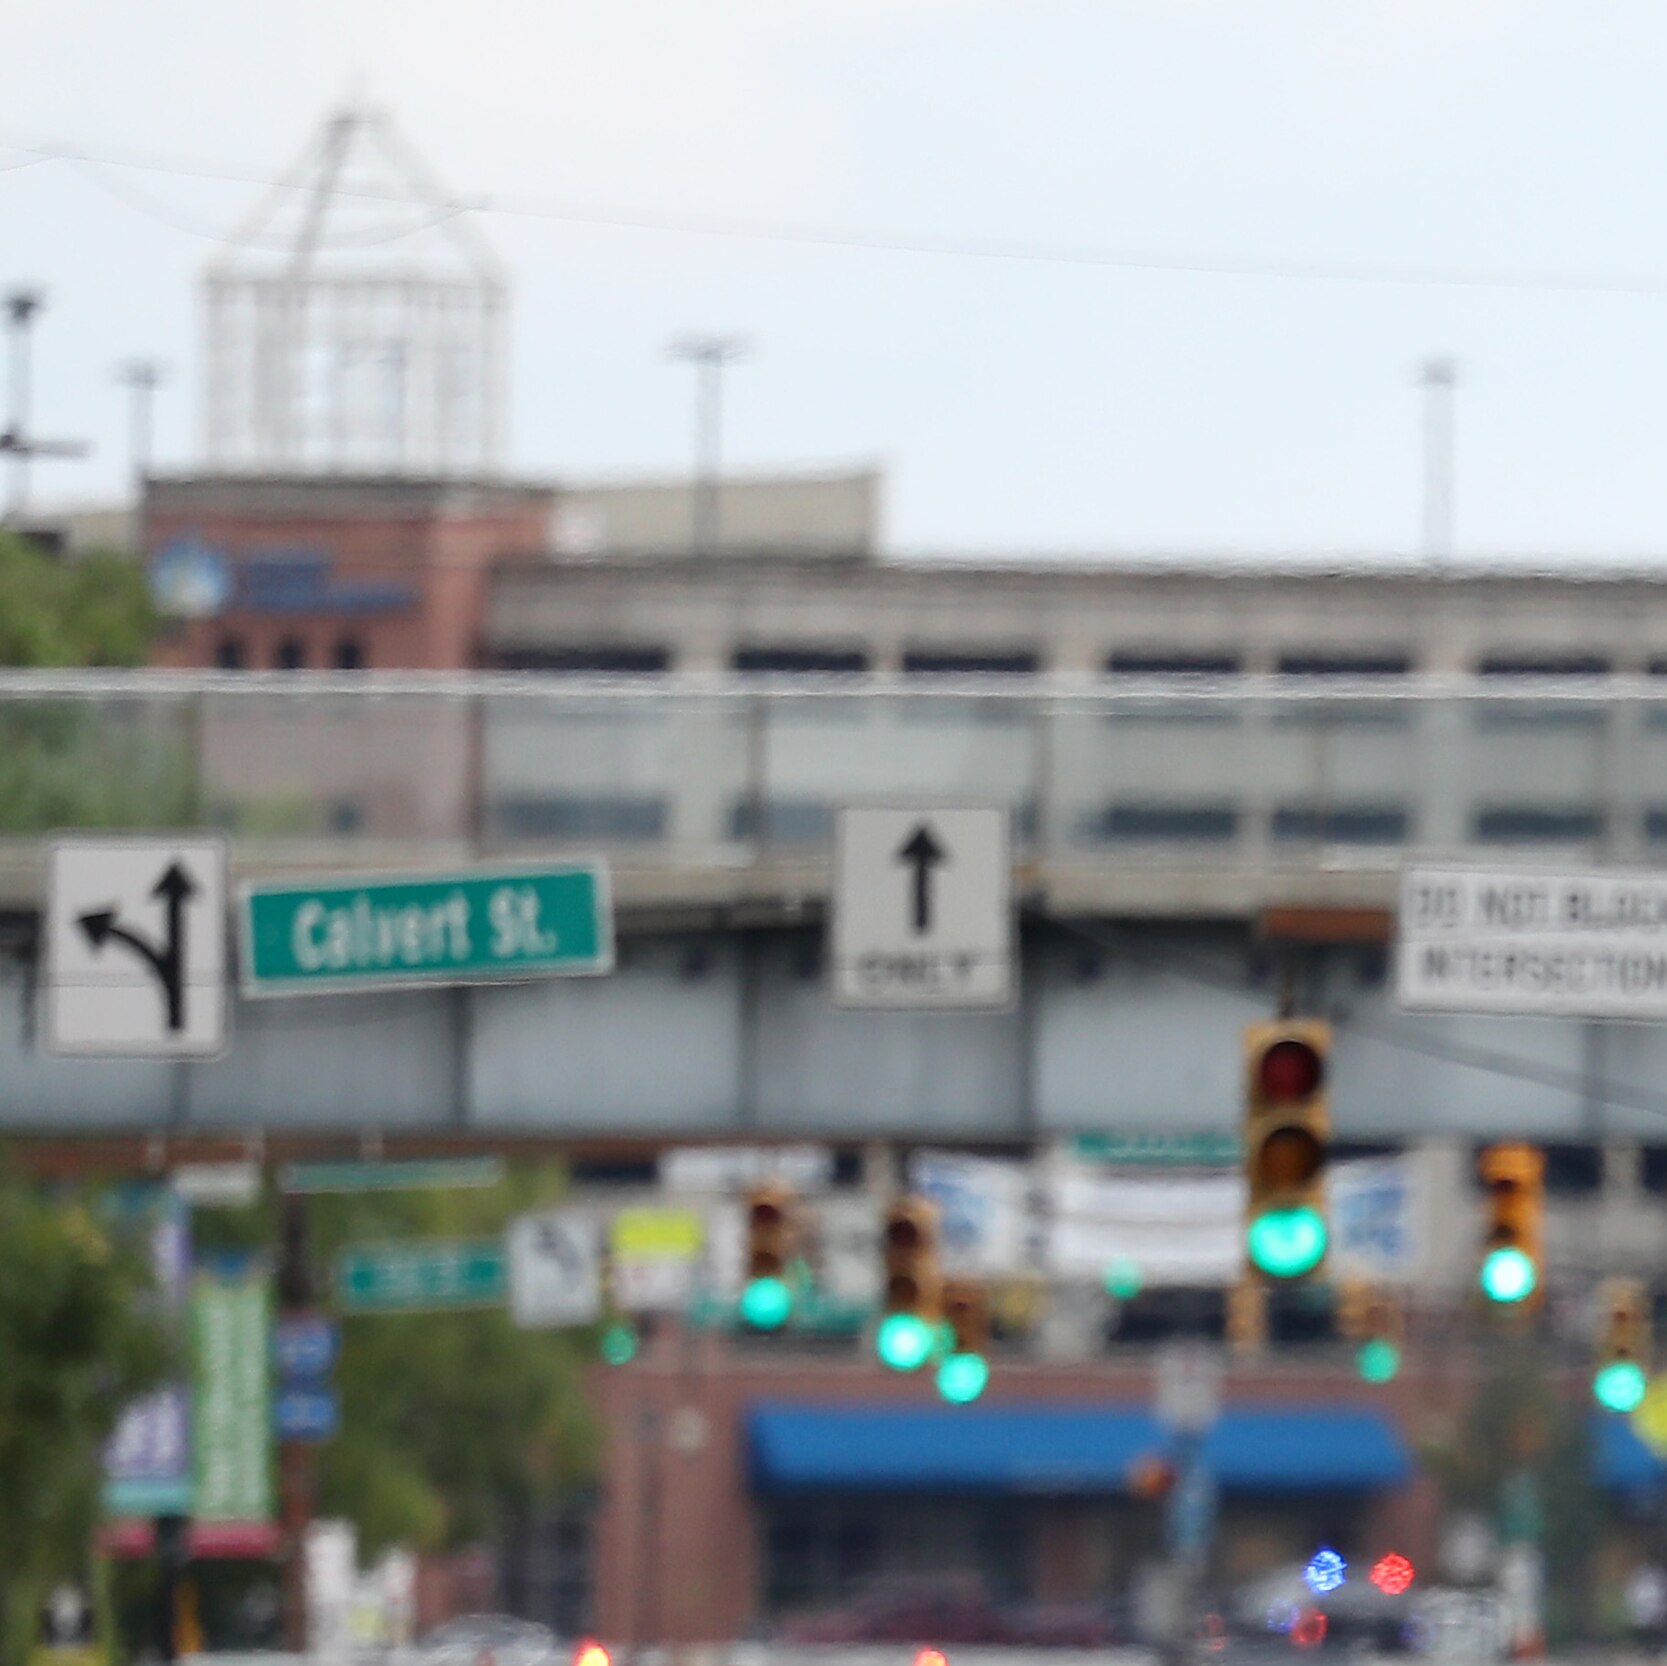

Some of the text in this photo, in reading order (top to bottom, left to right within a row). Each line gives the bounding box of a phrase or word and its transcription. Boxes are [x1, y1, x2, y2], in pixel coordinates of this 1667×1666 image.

[293, 889, 470, 967] Calvert
[1413, 881, 1462, 924] DO
[1477, 884, 1547, 927] NOT
